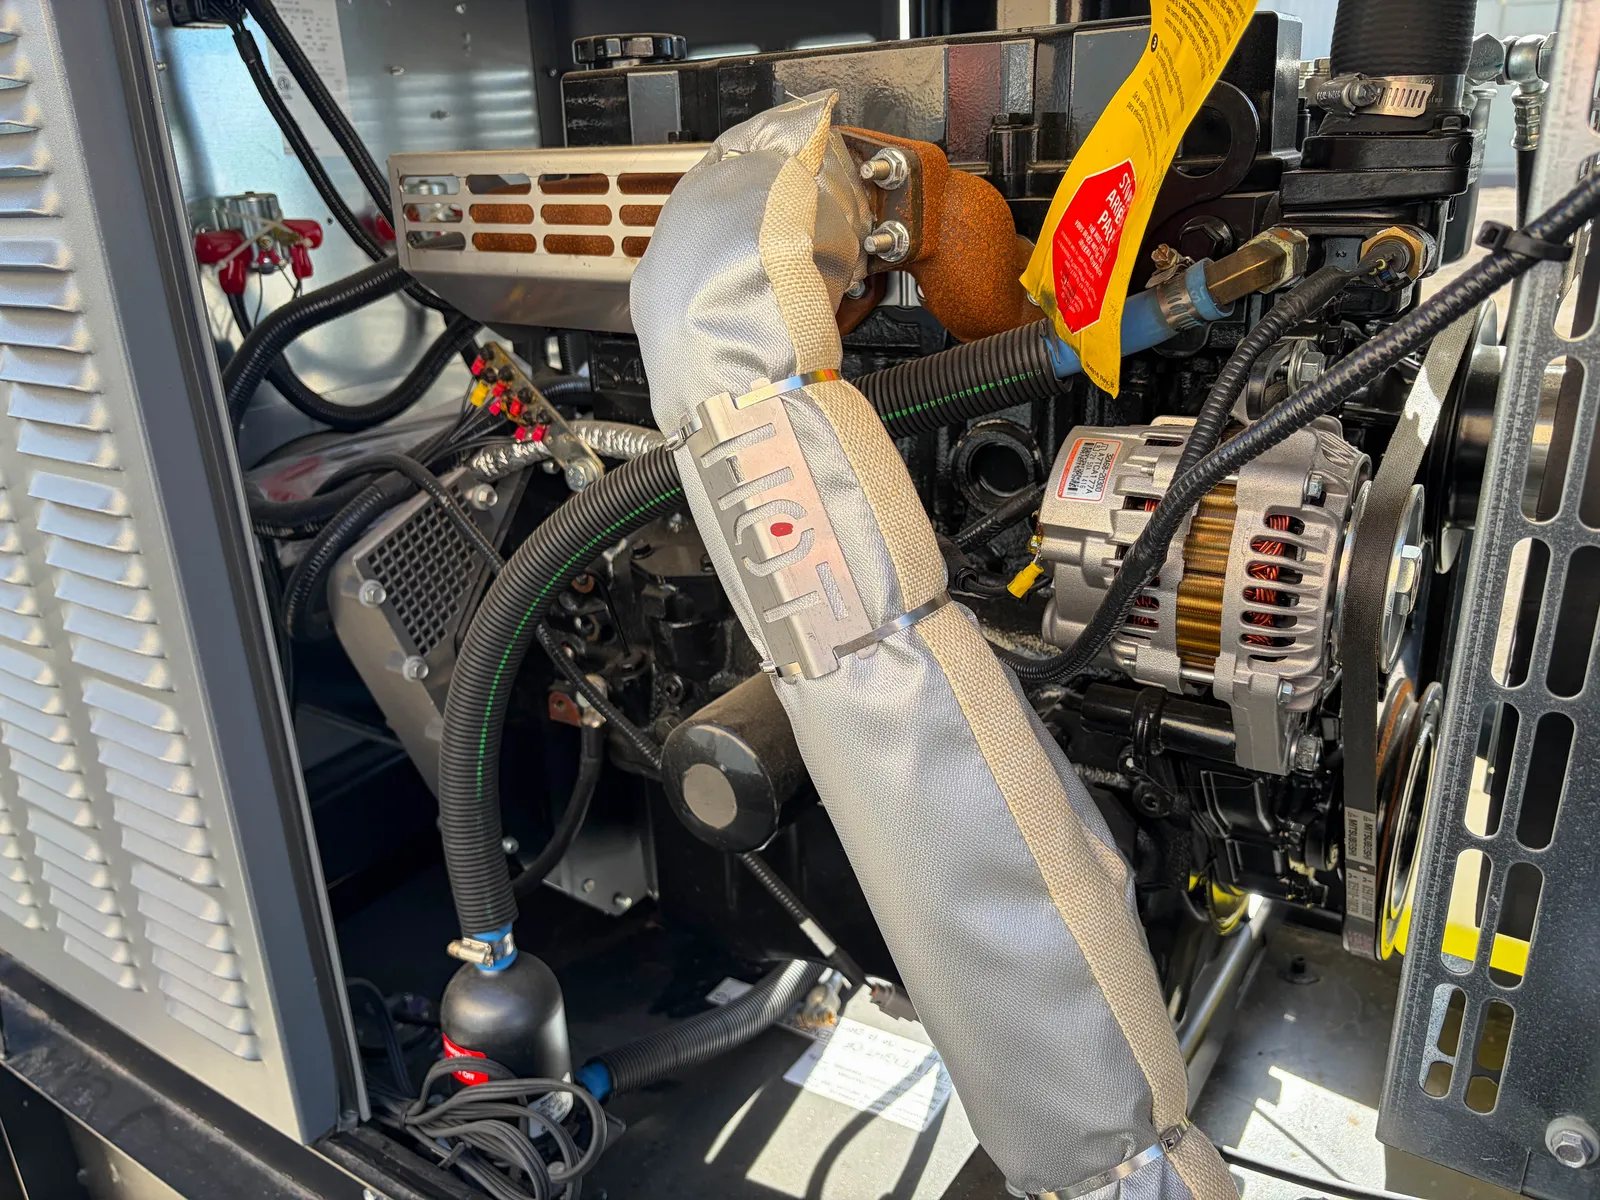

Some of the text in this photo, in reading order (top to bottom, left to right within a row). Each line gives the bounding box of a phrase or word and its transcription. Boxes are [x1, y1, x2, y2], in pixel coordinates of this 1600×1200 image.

[1086, 452, 1104, 495] A7TCA177A
[700, 422, 850, 623] HOT
[1080, 1173, 1112, 1193] PANDUIT
